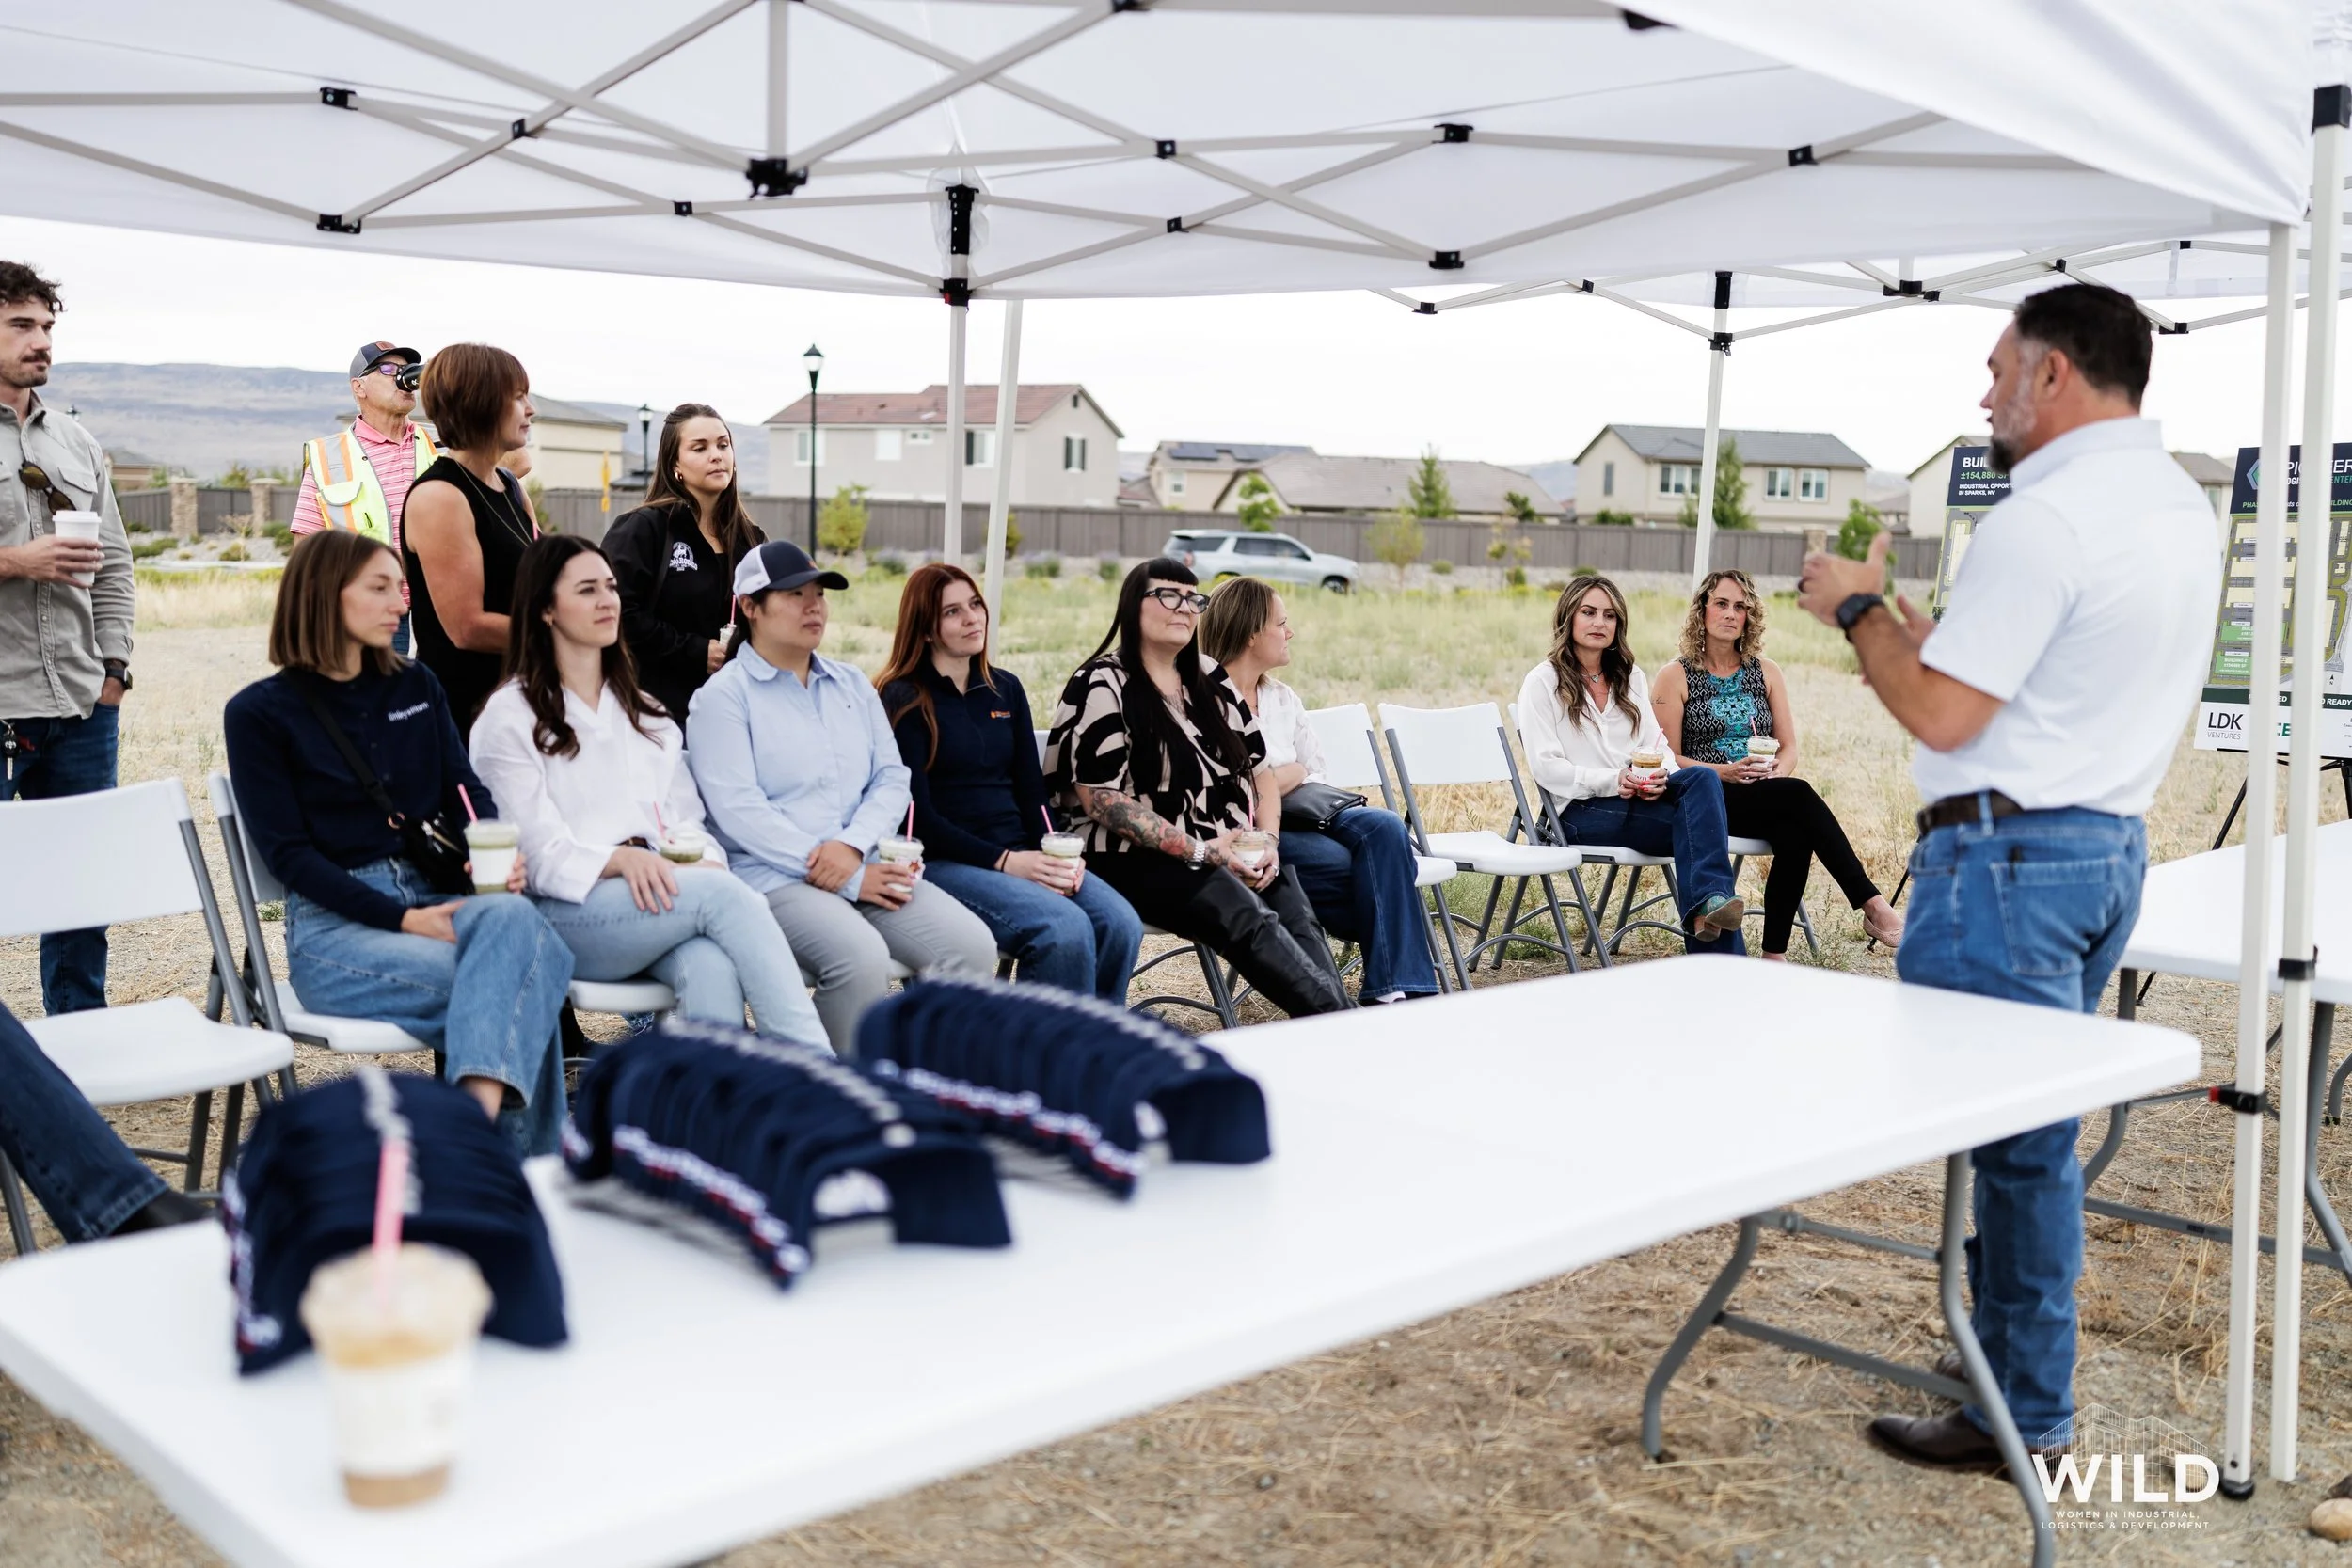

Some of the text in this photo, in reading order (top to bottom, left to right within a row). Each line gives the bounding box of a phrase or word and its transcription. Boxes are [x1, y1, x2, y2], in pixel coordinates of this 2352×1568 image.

[1963, 456, 1988, 468] BUIL
[2327, 698, 2352, 706] READY
[2207, 712, 2244, 730] LDK
[2207, 731, 2241, 740] VENTURES
